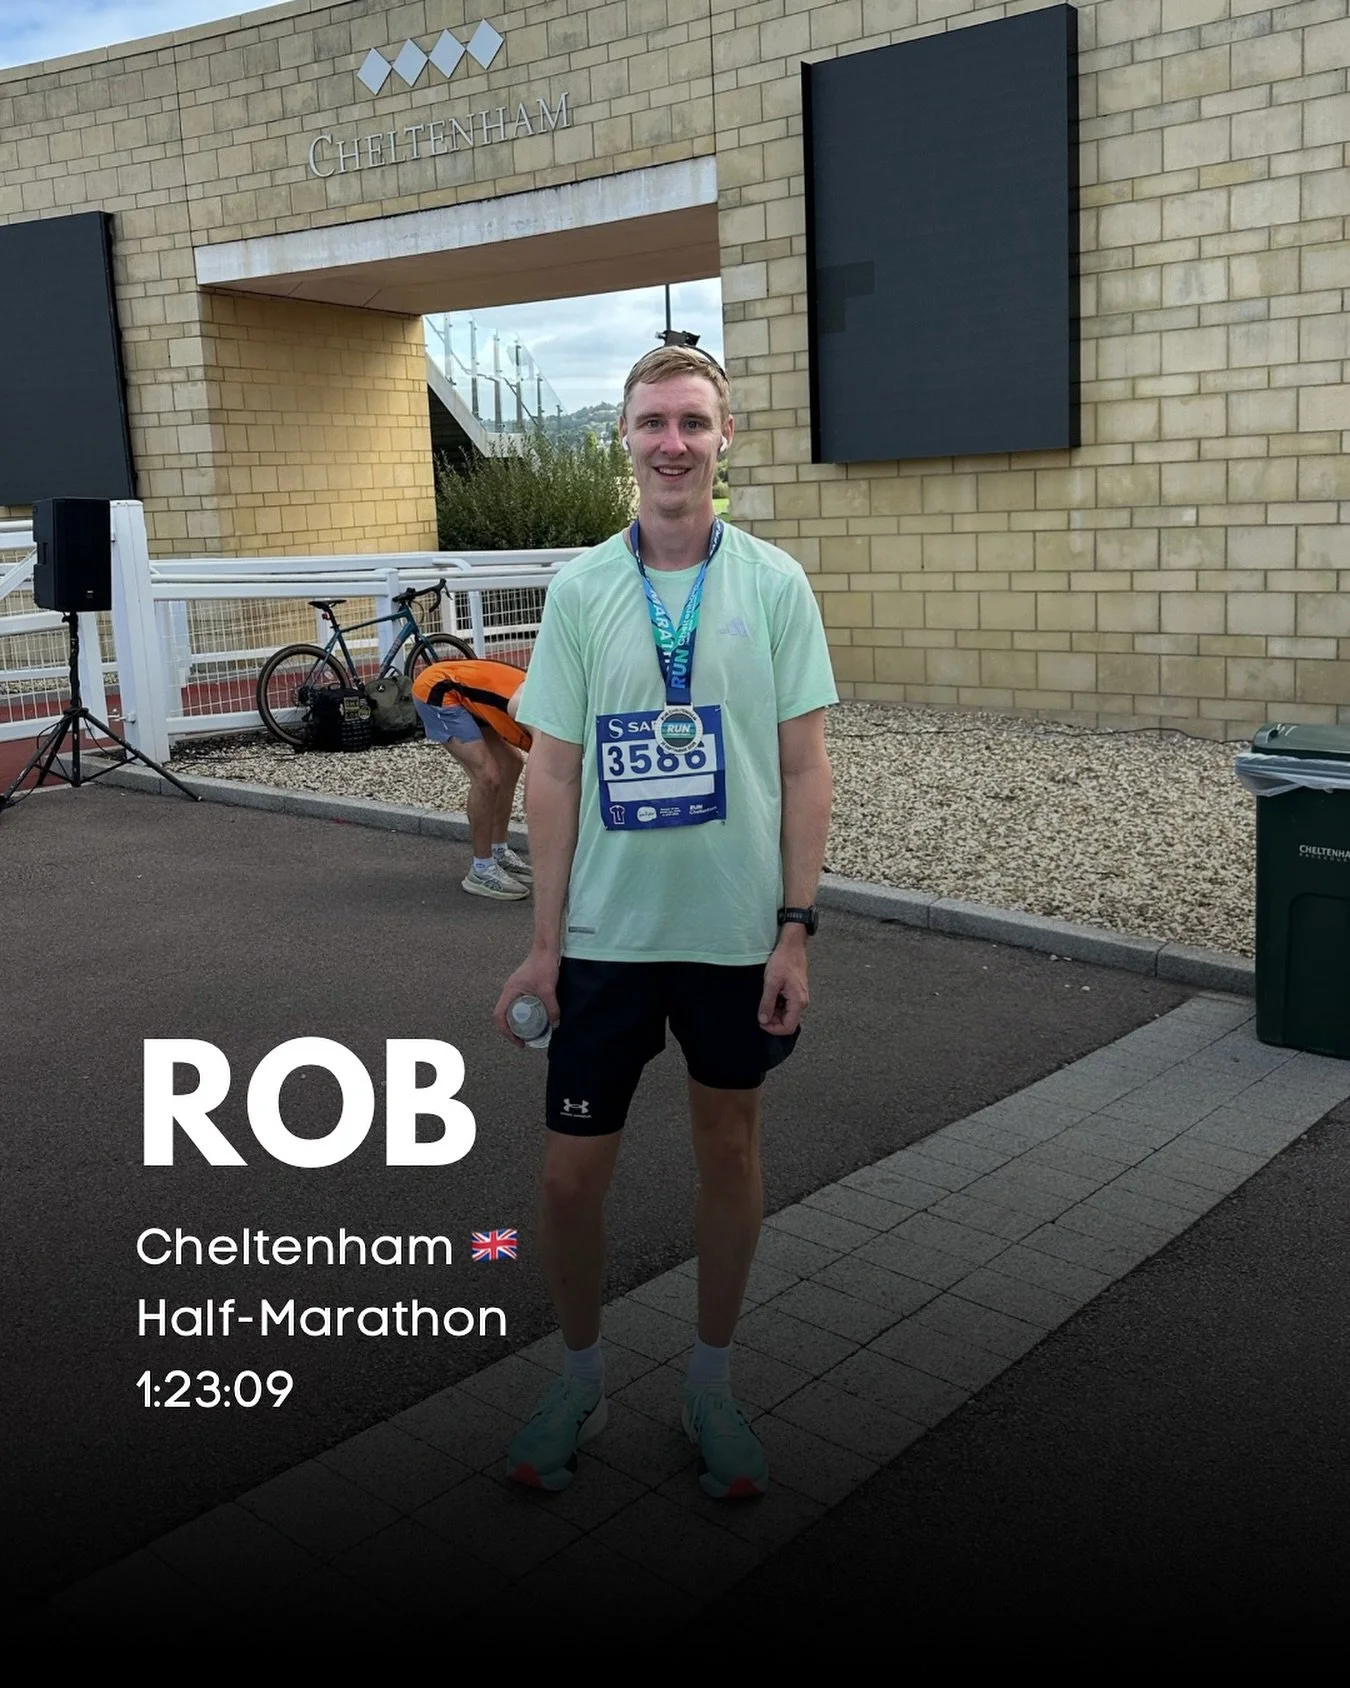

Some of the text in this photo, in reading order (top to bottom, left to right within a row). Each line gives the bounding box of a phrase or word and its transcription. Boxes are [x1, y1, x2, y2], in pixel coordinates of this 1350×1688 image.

[308, 91, 571, 178] CHELTENHAM
[670, 649, 690, 689] RUN
[666, 724, 691, 733] RUN
[607, 740, 706, 777] 3586
